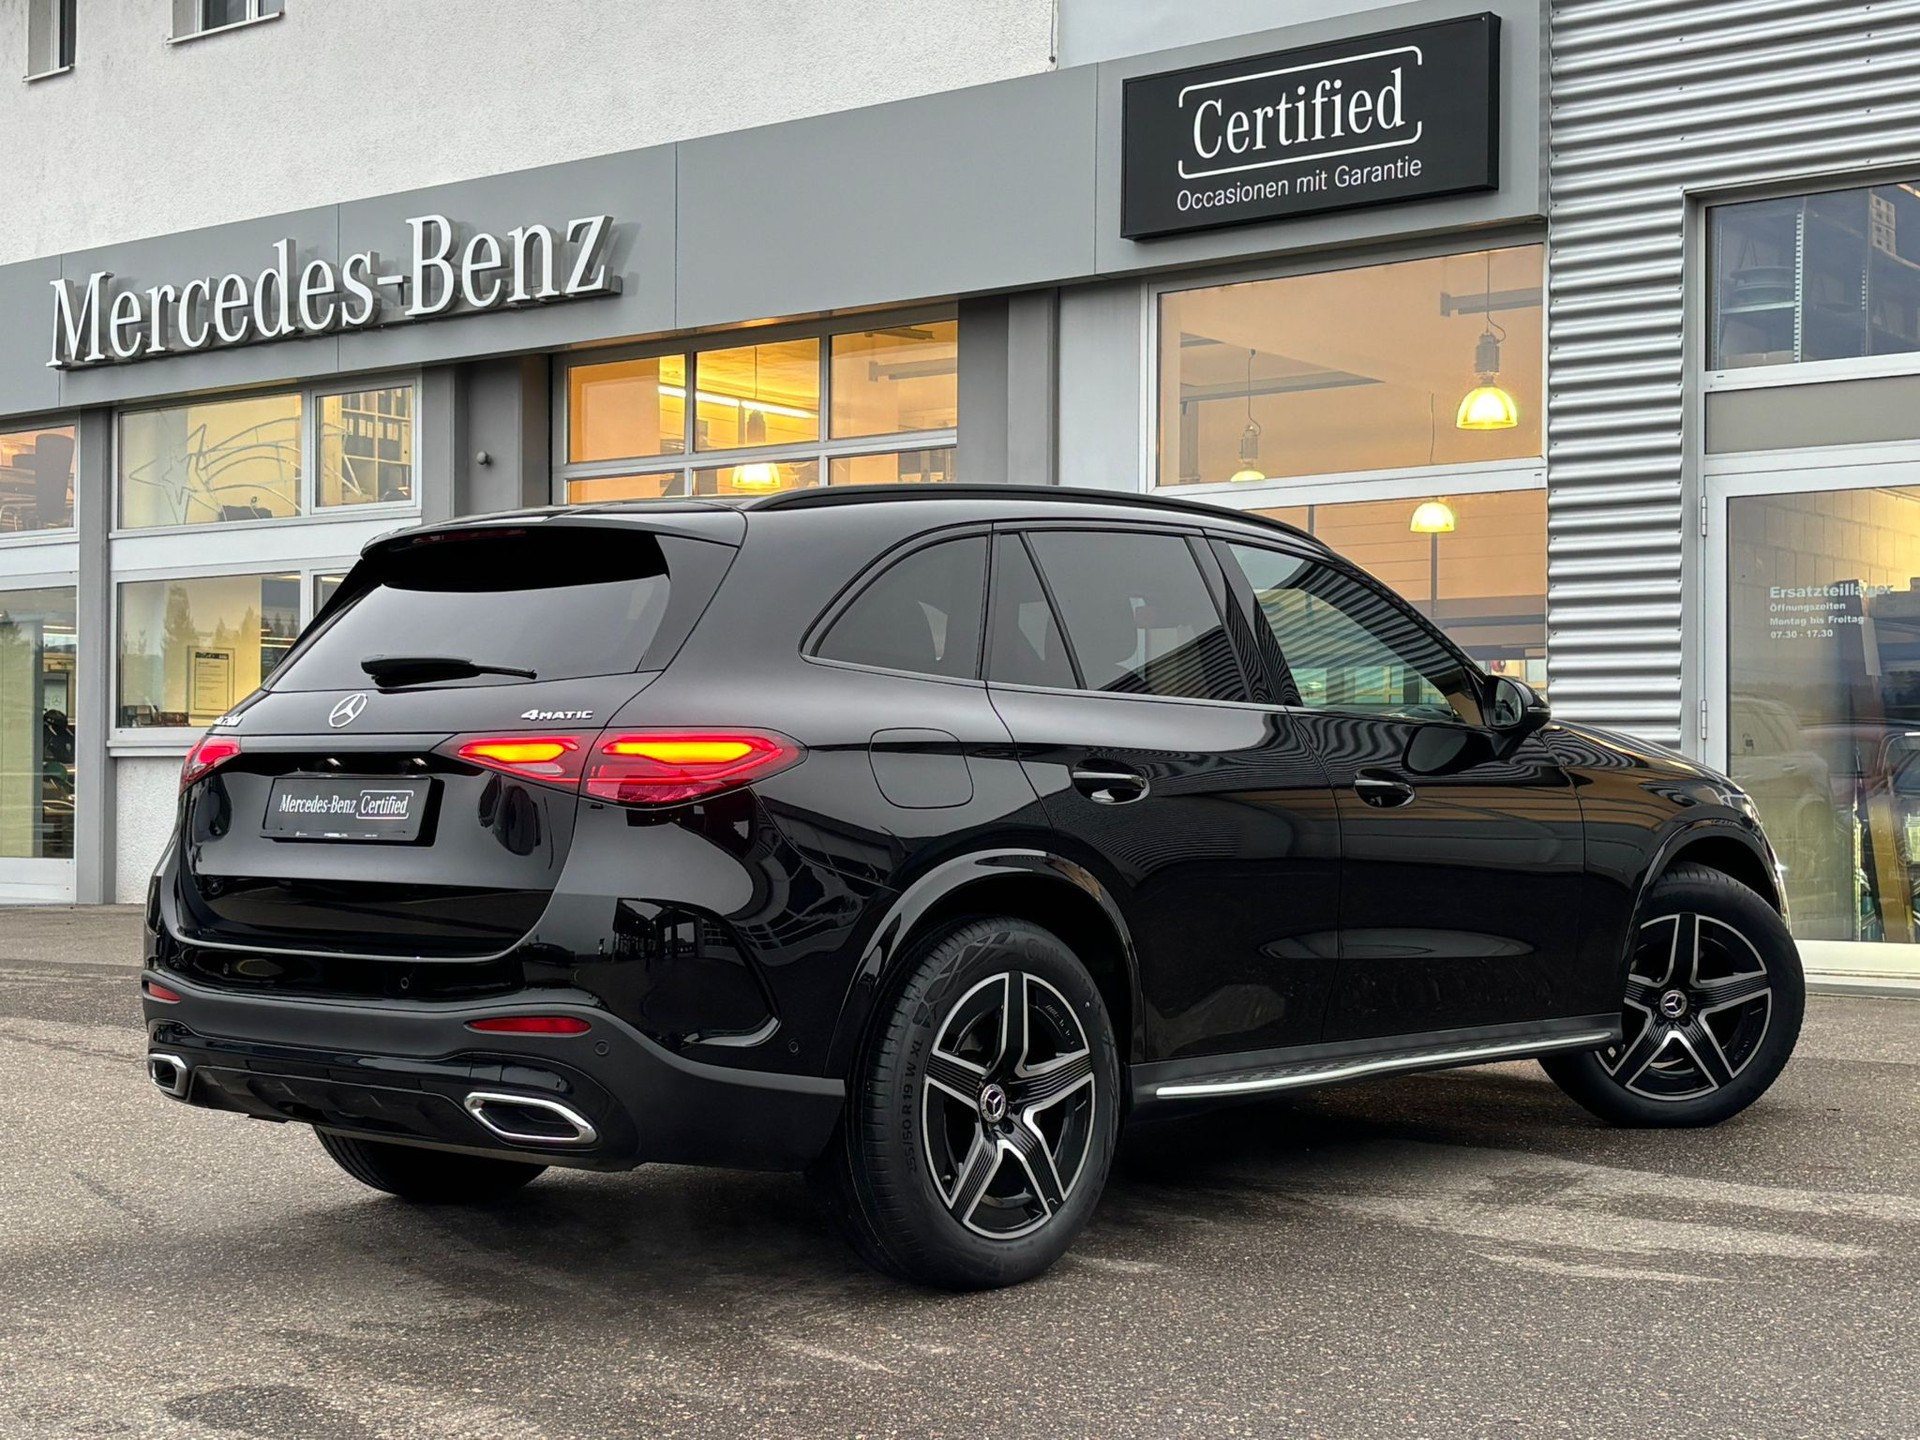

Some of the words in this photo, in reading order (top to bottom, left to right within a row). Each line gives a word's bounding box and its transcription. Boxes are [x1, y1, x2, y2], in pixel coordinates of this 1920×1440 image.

[1193, 66, 1406, 159] Certified
[1176, 181, 1289, 212] Occasionen
[1296, 169, 1328, 194] mit
[1334, 155, 1423, 188] Garantie
[46, 213, 614, 368] Mercedes-Benz
[1769, 582, 1894, 599] Ersatzteillager
[1769, 601, 1846, 613] Öffnungszeiten
[1769, 617, 1807, 627] Montag
[1810, 616, 1825, 625] bis
[1828, 614, 1865, 625] Freitag
[1770, 630, 1798, 639] 07.30
[1806, 629, 1834, 638] 17.30
[520, 709, 594, 721] 4MATIC
[278, 794, 357, 814] Mercedes-Benz
[360, 795, 409, 815] Certified
[903, 1083, 914, 1099] 19
